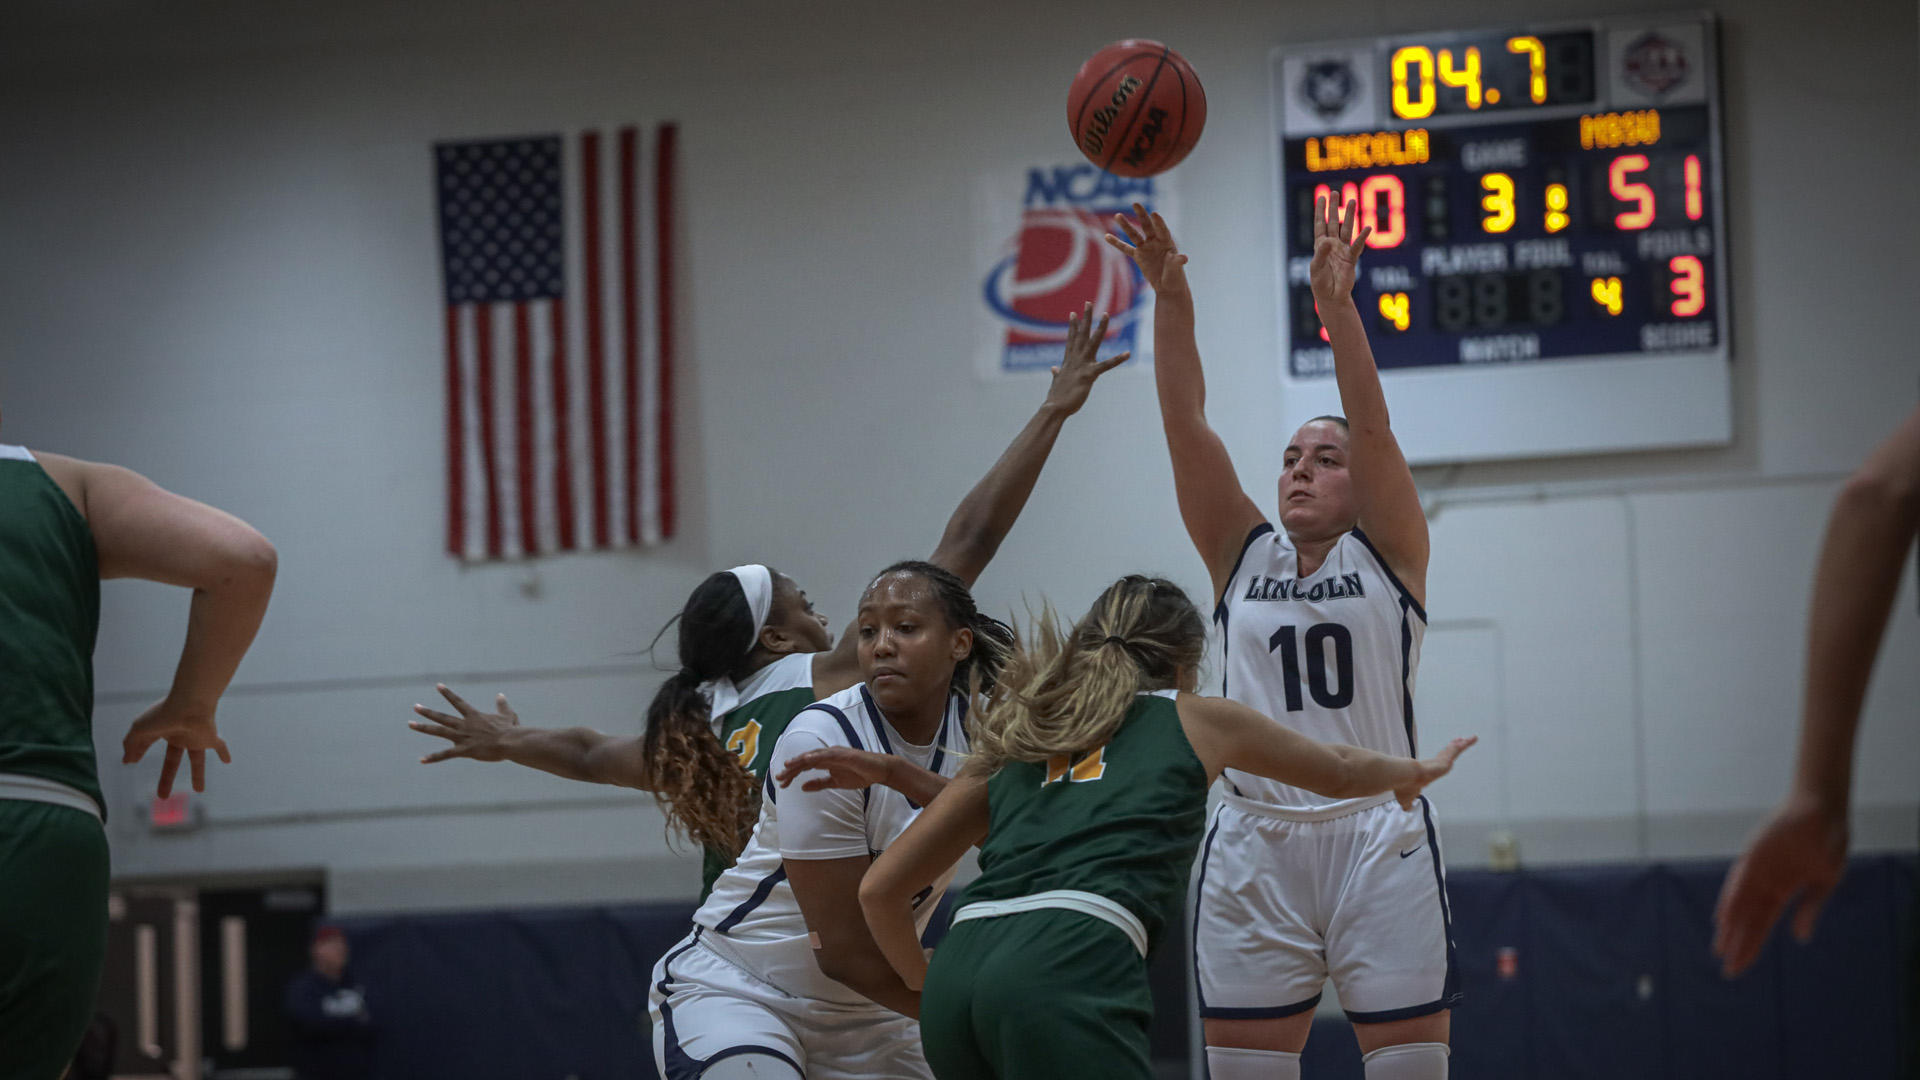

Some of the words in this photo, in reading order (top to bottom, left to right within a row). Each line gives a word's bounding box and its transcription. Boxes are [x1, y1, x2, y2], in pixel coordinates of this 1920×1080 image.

[1392, 36, 1547, 119] 04.7
[1084, 74, 1143, 155] Wilson
[1123, 106, 1169, 168] NCAA
[1306, 129, 1429, 172] LINCOLN
[1461, 138, 1528, 169] GAME
[1421, 244, 1508, 275] PLAYER
[1514, 238, 1572, 267] FOUL
[1638, 231, 1711, 259] FOULS
[1591, 277, 1623, 315] 4
[1669, 255, 1705, 317] 3
[1378, 292, 1410, 331] 4
[1458, 334, 1540, 363] MATCH
[1640, 322, 1714, 351] SCORE
[1243, 571, 1366, 603] LINCOLN
[1269, 623, 1354, 712] 10
